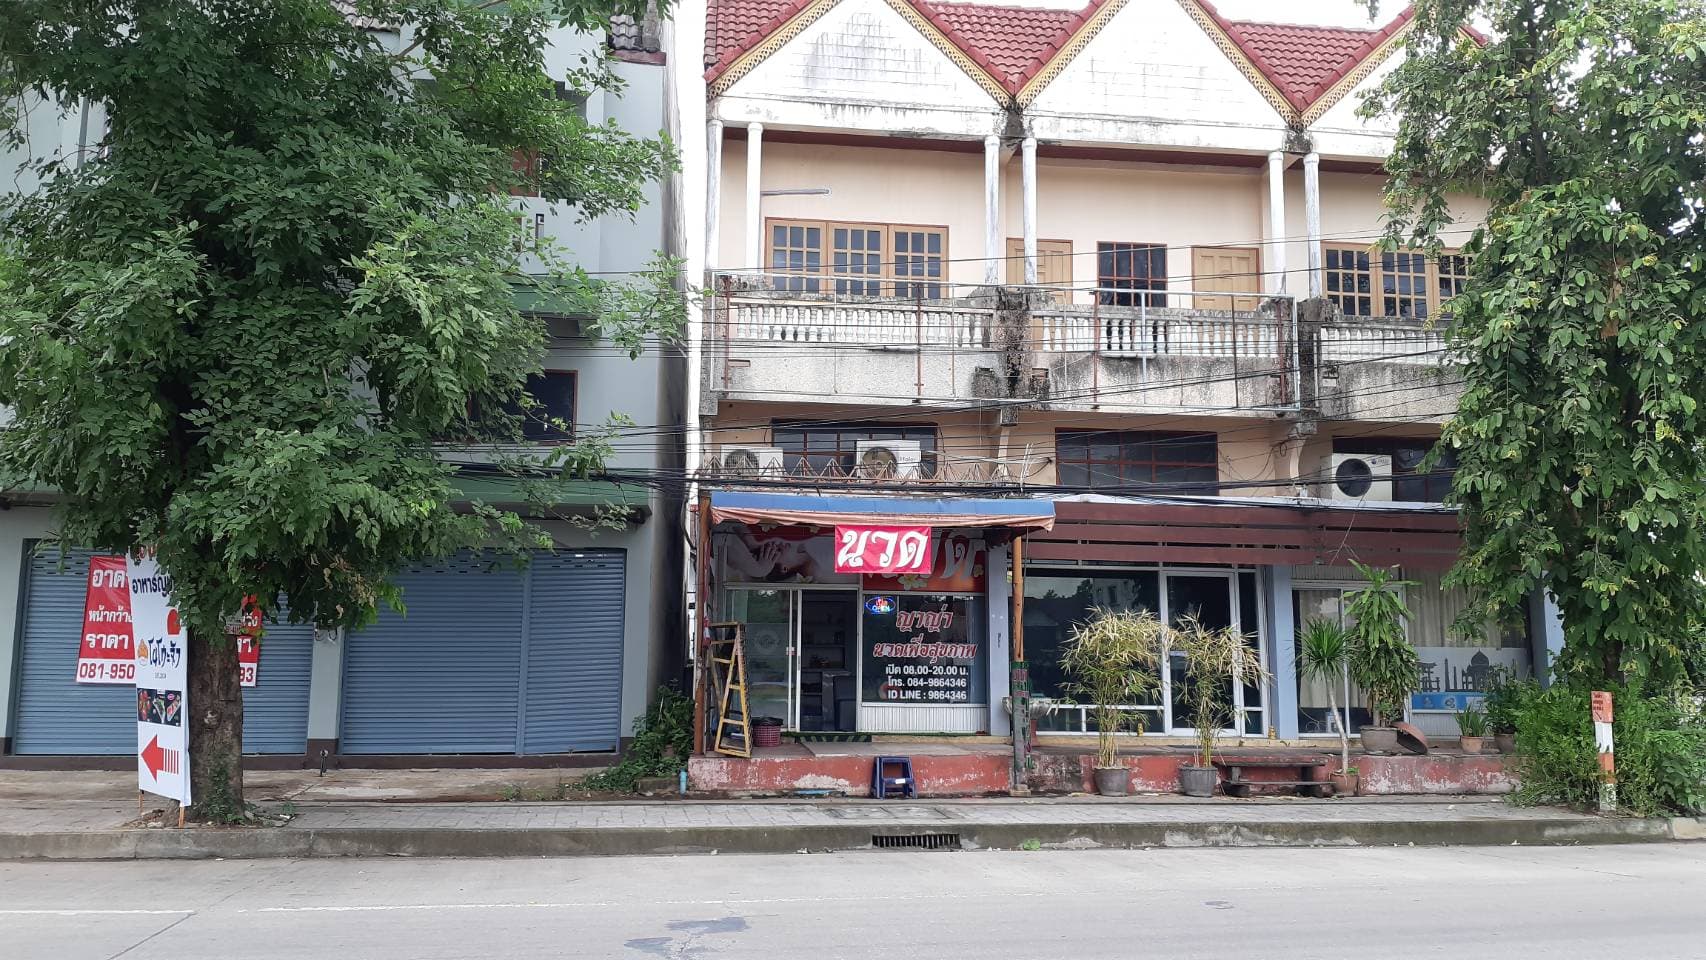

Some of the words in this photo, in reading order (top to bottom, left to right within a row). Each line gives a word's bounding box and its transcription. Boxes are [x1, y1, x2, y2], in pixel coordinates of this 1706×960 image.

[838, 530, 928, 568] นวด
[92, 569, 128, 588] อาค
[132, 575, 172, 597] อาหารญ
[896, 604, 953, 632] ญาญ่า
[85, 633, 129, 649] ราคา
[873, 633, 977, 664] นวดเพื่อสุขภาพ
[79, 663, 135, 680] 081-950
[885, 664, 901, 675] เปิด
[903, 665, 957, 675] 08.00-20.00
[959, 667, 969, 675] น.
[888, 676, 905, 687] โทร.
[907, 678, 967, 687] 084-9864346
[888, 690, 898, 699] ID
[900, 690, 921, 699] LINE
[928, 690, 967, 700] 9864346
